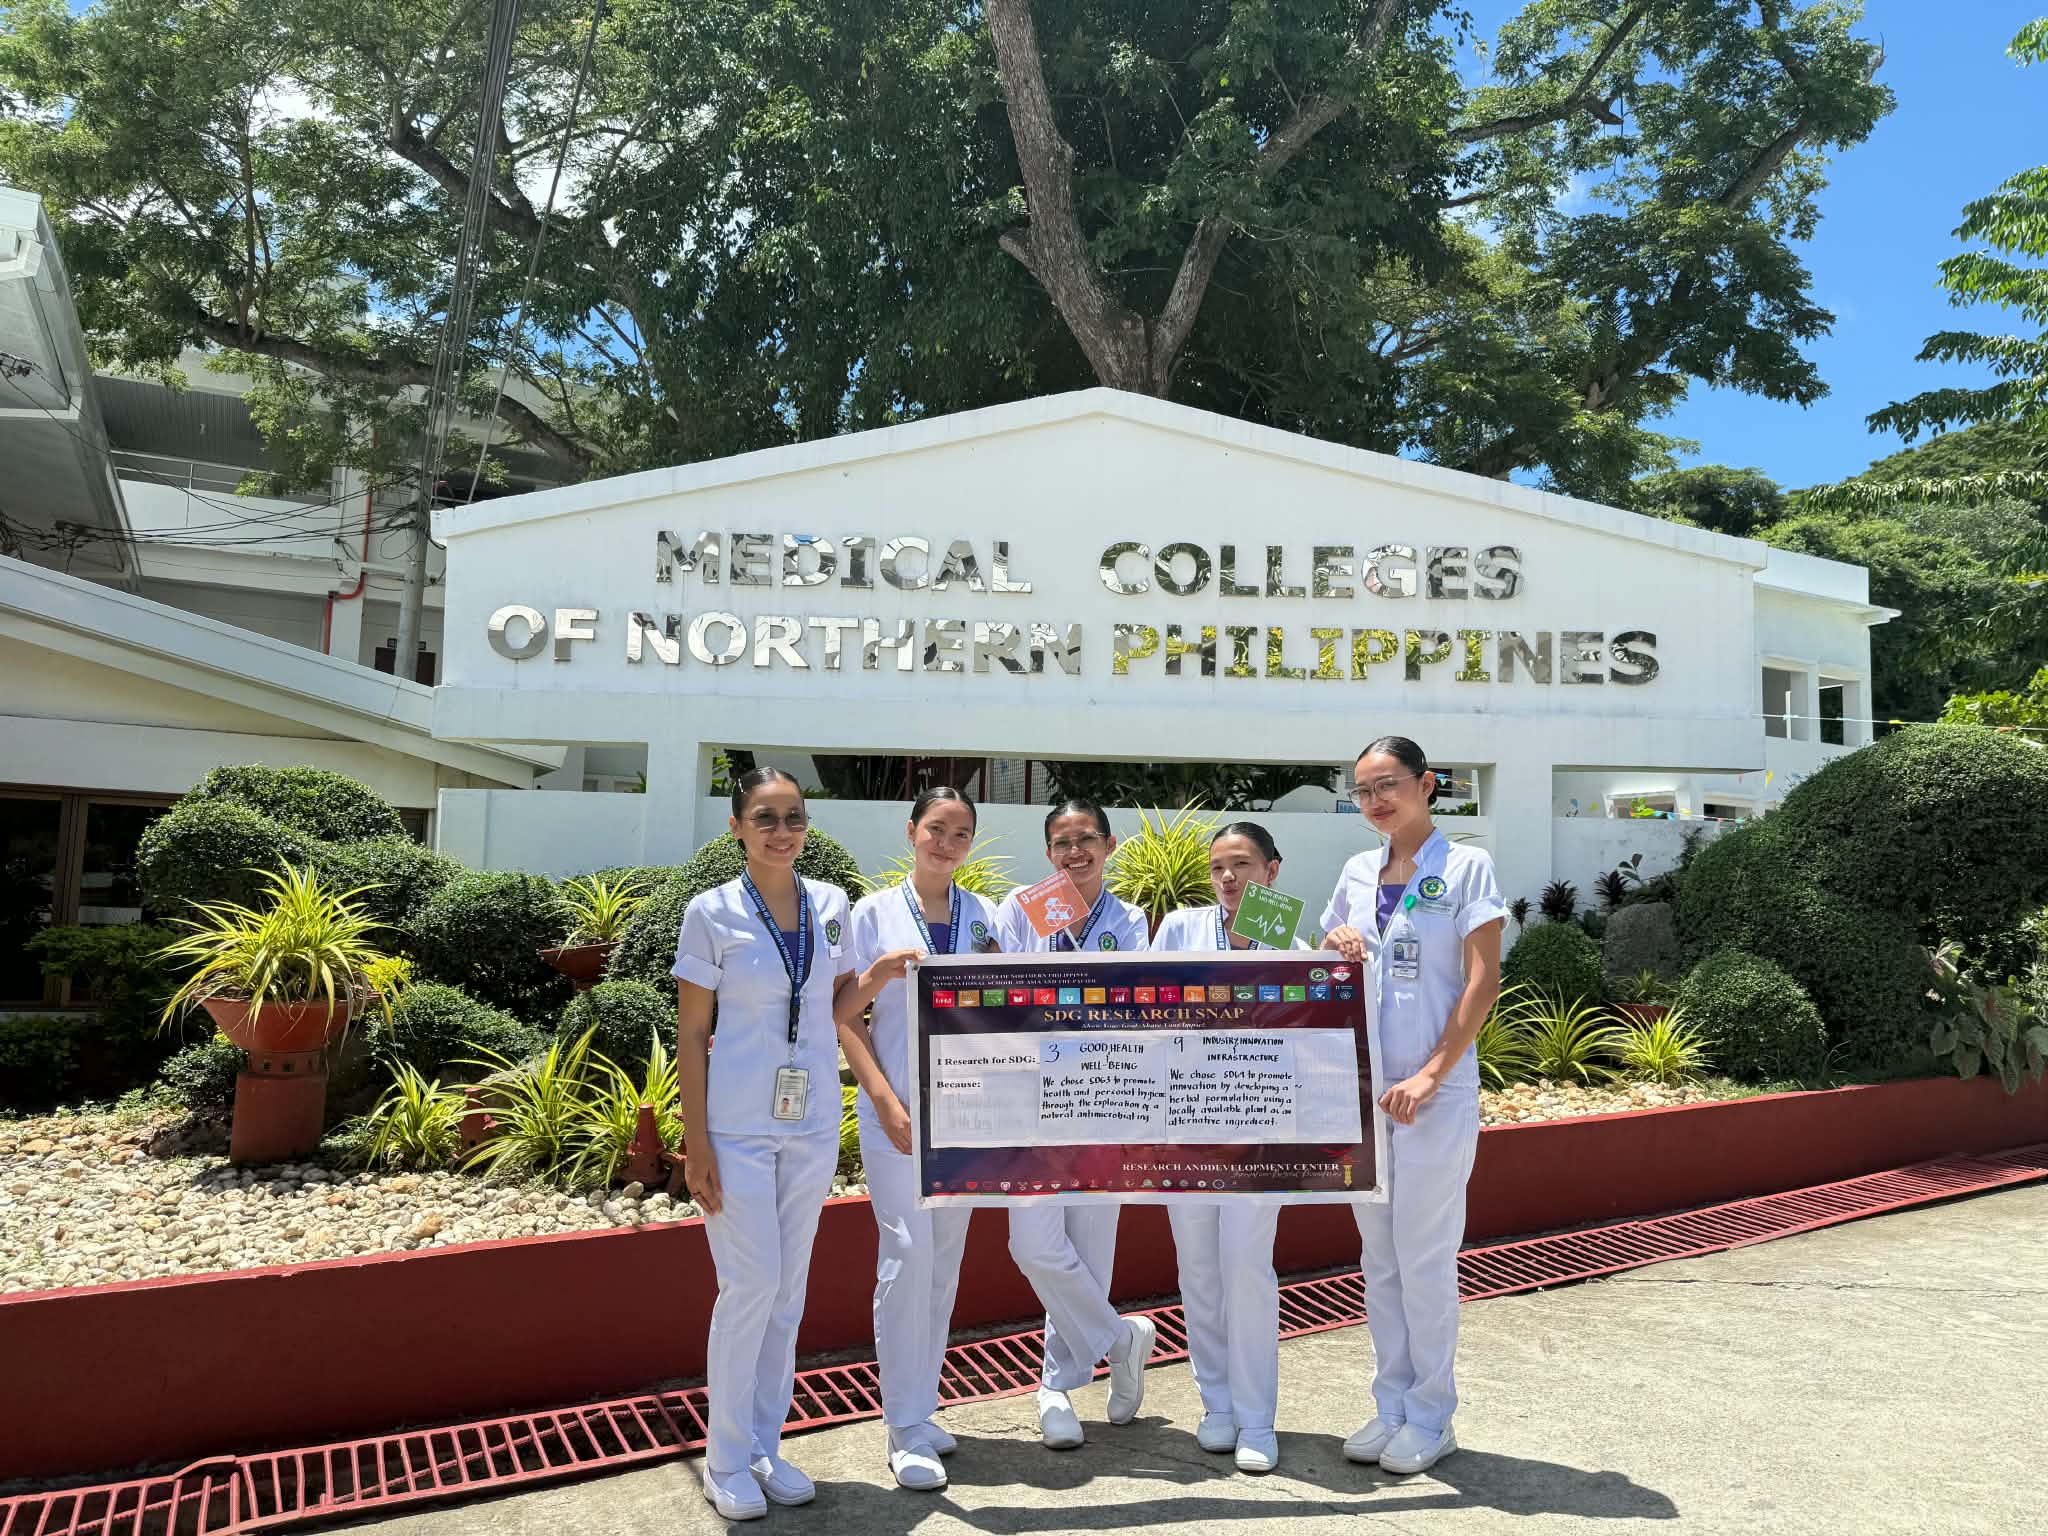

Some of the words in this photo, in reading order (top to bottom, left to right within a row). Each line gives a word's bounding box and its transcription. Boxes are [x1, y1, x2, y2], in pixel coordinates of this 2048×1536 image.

[656, 530, 1033, 593] MEDICAL
[1099, 541, 1524, 601] COLLEGES
[487, 604, 598, 661] OF
[627, 611, 1083, 676] NORTHERN
[1111, 623, 1660, 686] PHILIPPINES
[1248, 885, 1258, 897] 3
[1044, 1009, 1082, 1022] SDG
[1088, 1008, 1191, 1021] RESEARCH
[1196, 1007, 1245, 1020] SNAP
[1080, 1043, 1108, 1053] GOOD
[1110, 1043, 1144, 1054] HEALTH
[1174, 1036, 1184, 1053] 9
[1044, 1043, 1060, 1063] 3
[937, 1058, 942, 1066] I
[944, 1057, 989, 1065] Research
[991, 1056, 1007, 1064] for
[1008, 1055, 1036, 1064] SDG:
[1081, 1060, 1138, 1071] WELL-BEING
[1043, 1075, 1055, 1088] We
[1060, 1075, 1084, 1087] chose
[1123, 1077, 1156, 1088] promote
[1170, 1068, 1184, 1080] We
[1190, 1069, 1216, 1079] chose
[1248, 1069, 1256, 1079] to
[1258, 1071, 1293, 1082] promote
[936, 1081, 981, 1089] Because:
[1170, 1081, 1217, 1091] innovation
[1220, 1081, 1231, 1094] by
[1234, 1081, 1280, 1095] developing
[1043, 1088, 1071, 1098] health
[1073, 1088, 1090, 1096] and
[1095, 1087, 1135, 1099] personal
[1041, 1099, 1074, 1111] through
[1078, 1098, 1091, 1107] the
[1093, 1097, 1140, 1109] exploration
[1169, 1093, 1200, 1104] herbal
[1263, 1094, 1284, 1107] using
[1041, 1109, 1073, 1120] natural
[1169, 1105, 1196, 1117] locally
[1201, 1104, 1241, 1113] available
[1245, 1105, 1267, 1116] plant
[1168, 1115, 1221, 1126] alternative
[1122, 1163, 1181, 1171] RESEARCH
[1293, 1163, 1340, 1171] CENTER
